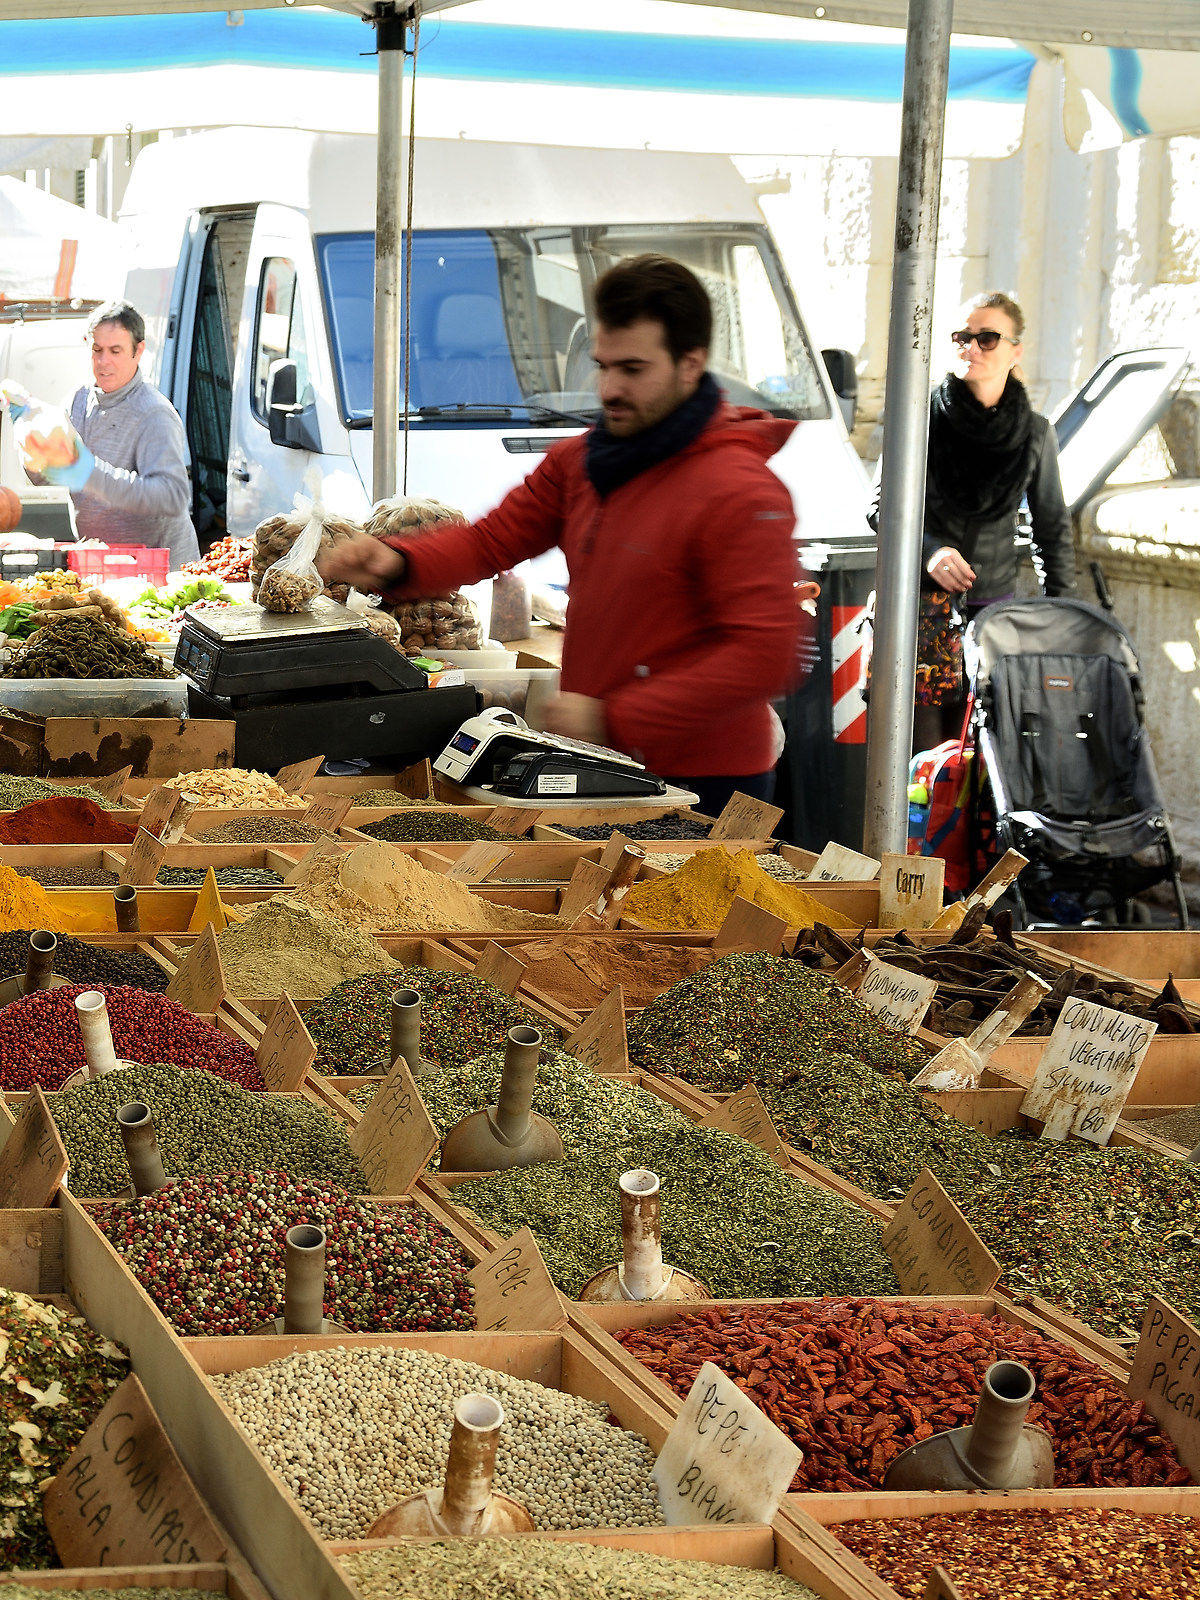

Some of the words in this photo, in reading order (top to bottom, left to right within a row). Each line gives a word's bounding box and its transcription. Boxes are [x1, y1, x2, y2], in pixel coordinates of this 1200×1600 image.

[896, 867, 926, 900] Carry
[863, 967, 919, 1003] CONDIMENTO
[270, 1001, 299, 1051] PEPE
[1063, 1002, 1149, 1055] CONDIMENTO
[376, 1072, 413, 1137] PEPE
[1080, 1106, 1105, 1134] BIO
[485, 1247, 531, 1297] PEPE
[695, 1383, 749, 1454] PEPE
[66, 1455, 112, 1536] ALLA
